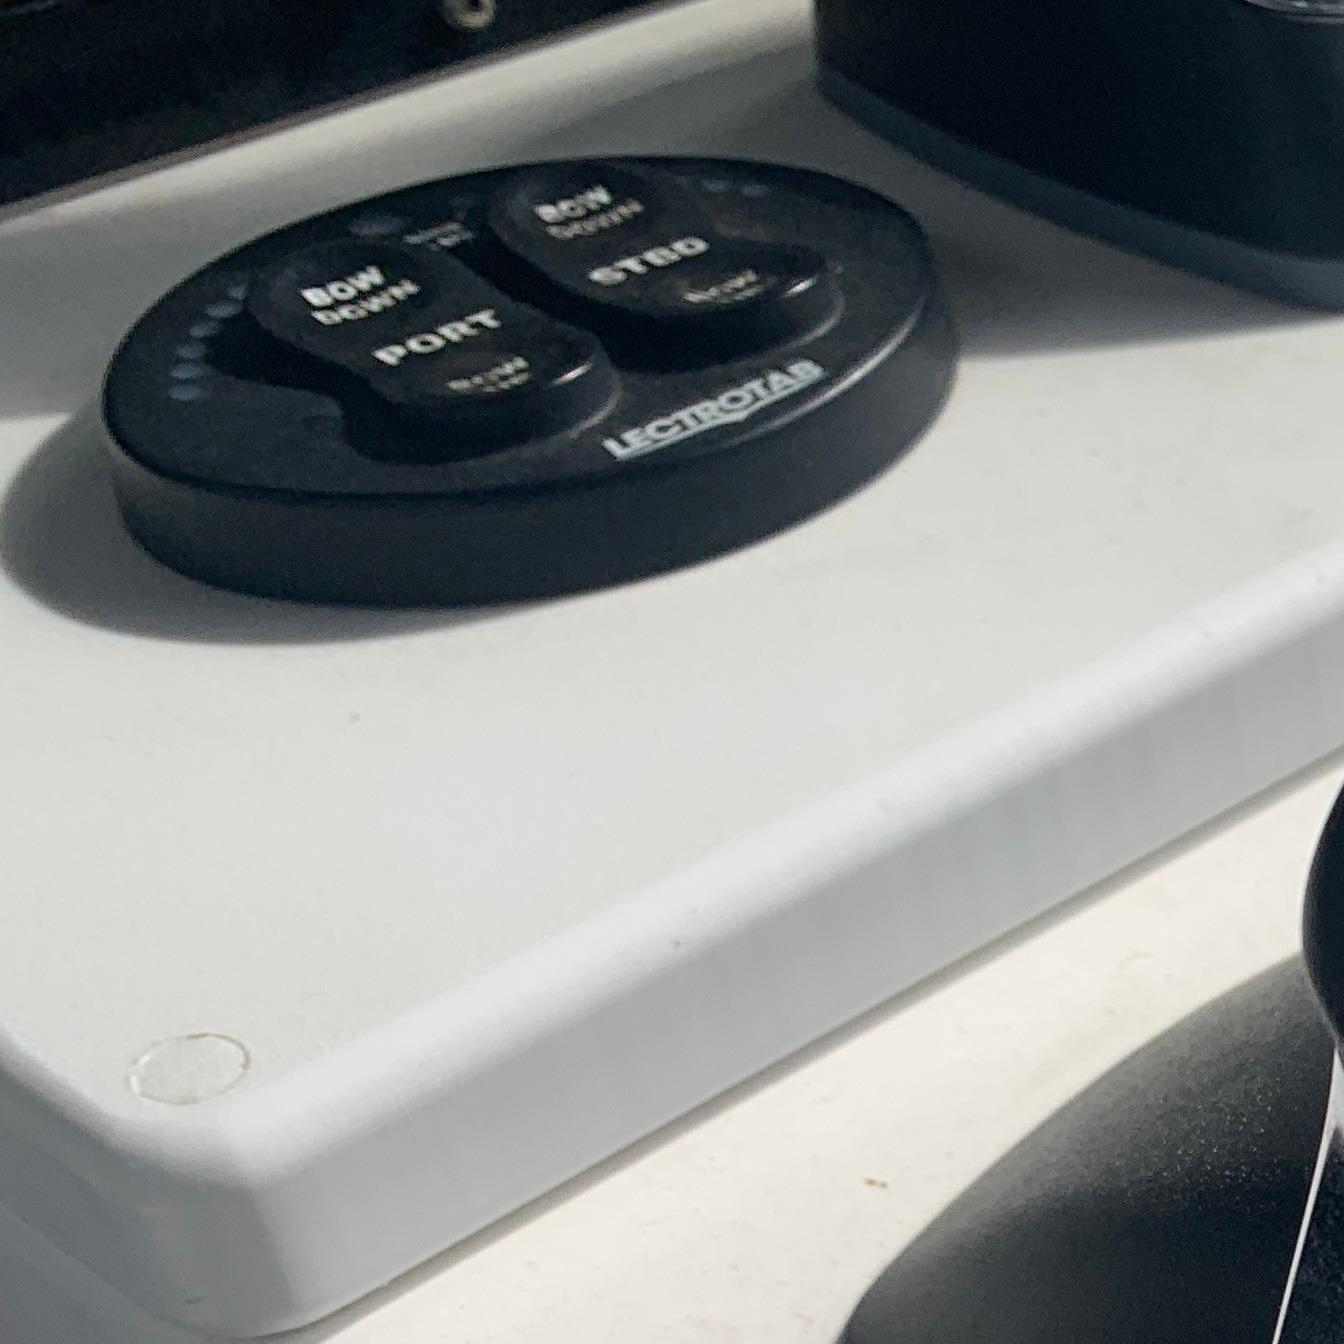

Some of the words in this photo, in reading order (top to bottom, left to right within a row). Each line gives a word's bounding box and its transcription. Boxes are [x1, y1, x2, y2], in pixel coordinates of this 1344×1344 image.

[533, 185, 611, 222] BOW
[301, 265, 384, 307] BOW
[311, 280, 420, 325] DOWN
[371, 309, 501, 366] PORT
[602, 359, 824, 461] LECTROTAB
